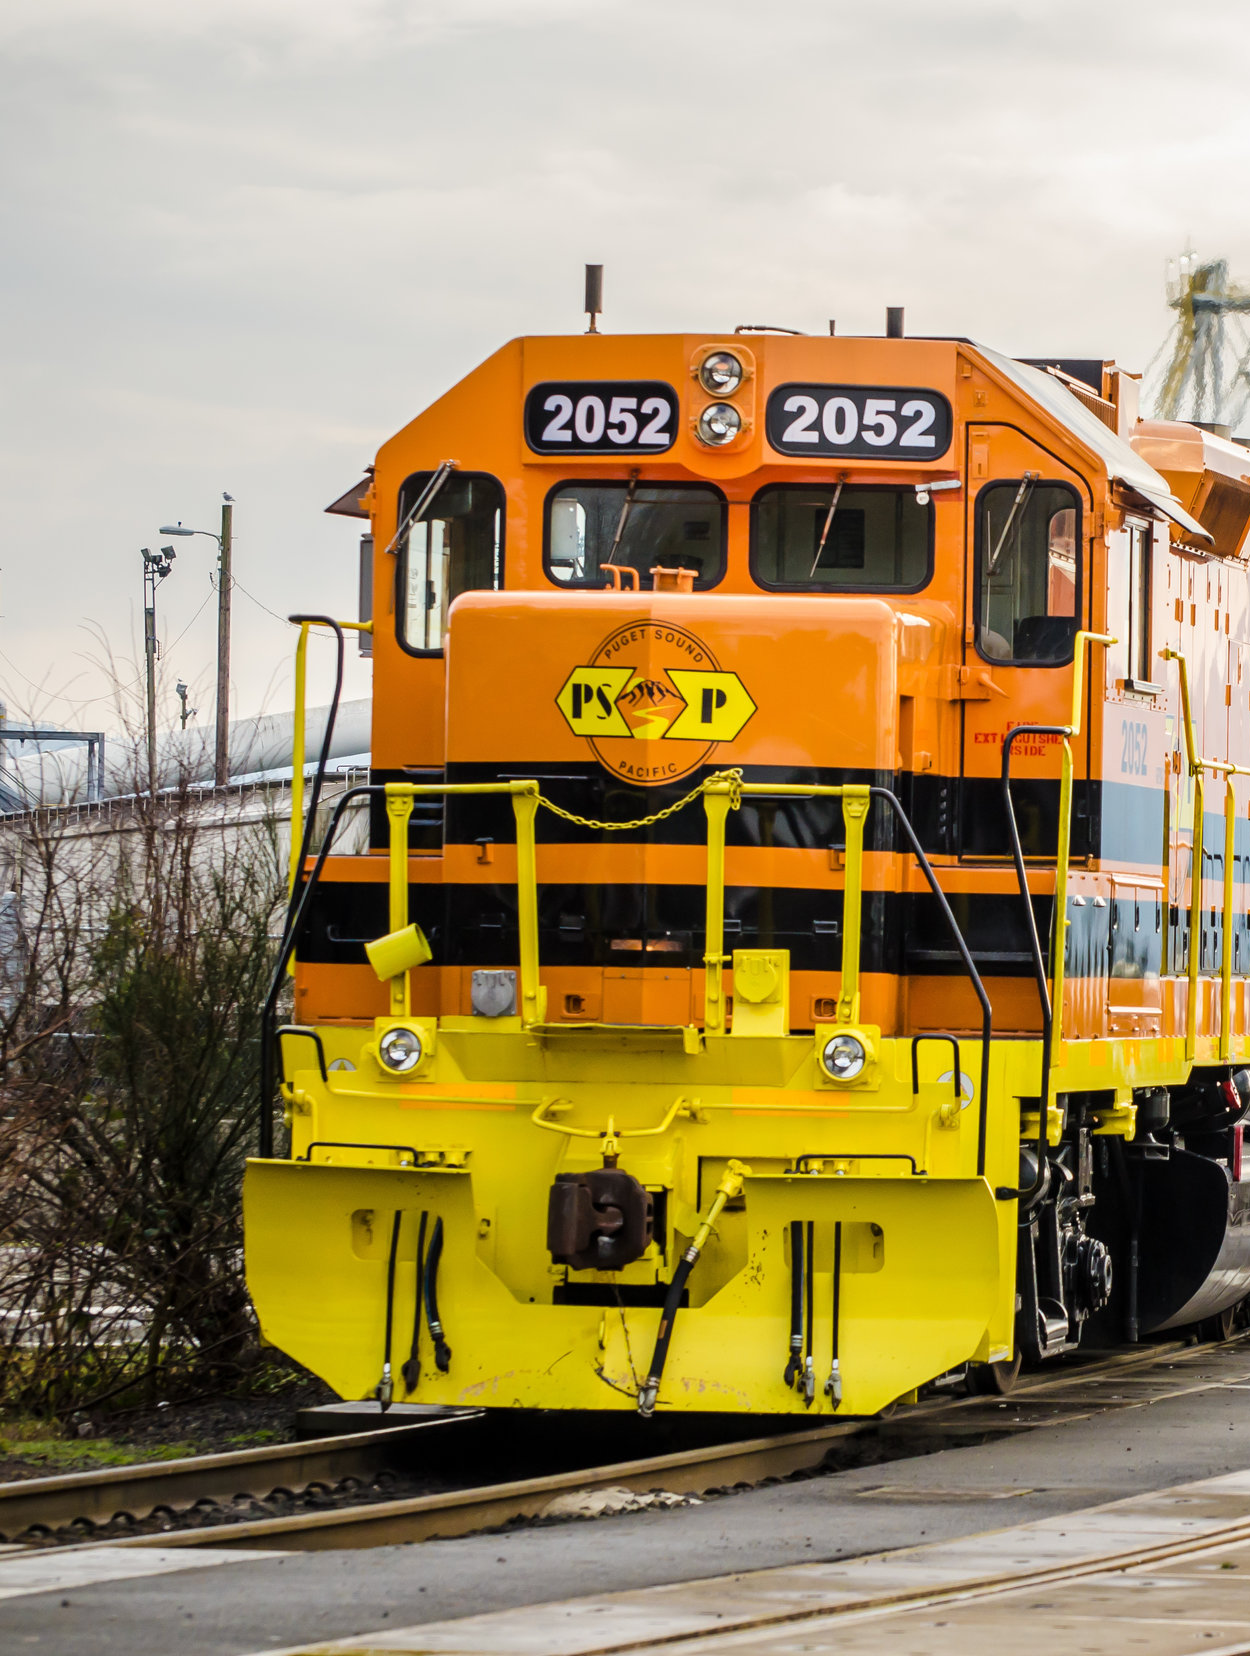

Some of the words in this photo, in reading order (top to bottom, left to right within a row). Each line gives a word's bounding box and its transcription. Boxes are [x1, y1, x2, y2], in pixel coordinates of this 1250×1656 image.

[541, 394, 671, 445] 2052
[782, 395, 936, 448] 2052
[604, 629, 646, 659] PUGET
[655, 630, 704, 663] SOUND
[572, 683, 612, 720] PS
[701, 688, 727, 724] P
[1121, 719, 1148, 776] 2052
[618, 761, 677, 778] PACIFIC
